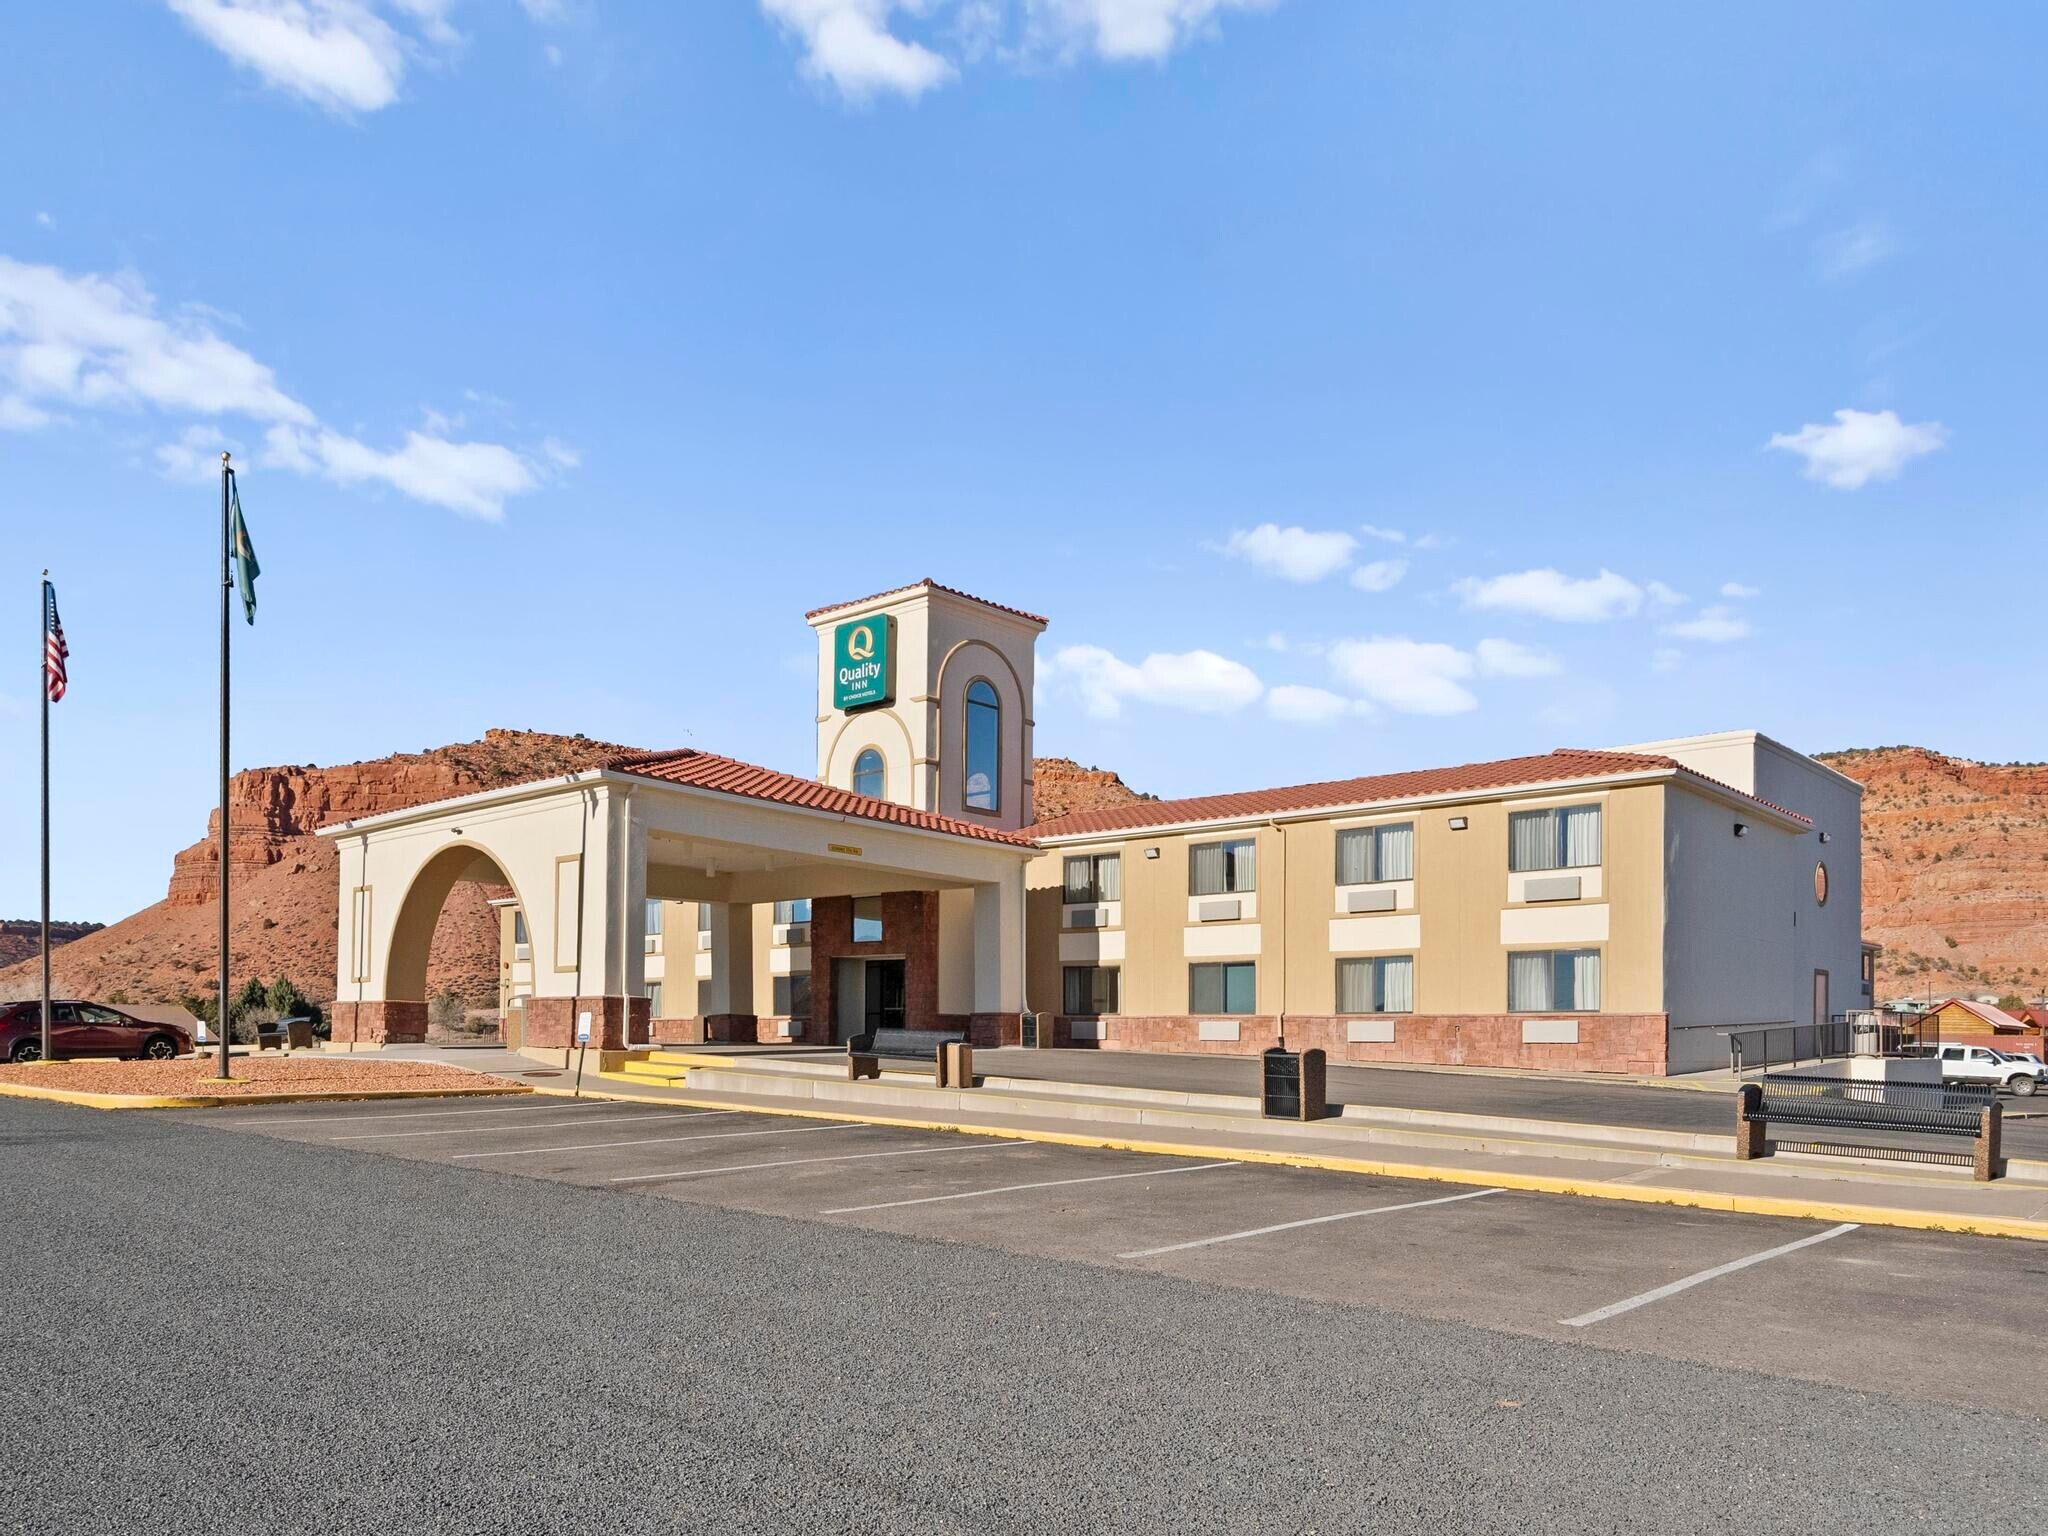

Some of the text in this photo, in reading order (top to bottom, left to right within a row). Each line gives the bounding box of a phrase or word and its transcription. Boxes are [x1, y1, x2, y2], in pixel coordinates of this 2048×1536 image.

[848, 626, 875, 660] Q
[839, 662, 880, 684] Quality
[851, 679, 868, 691] INN
